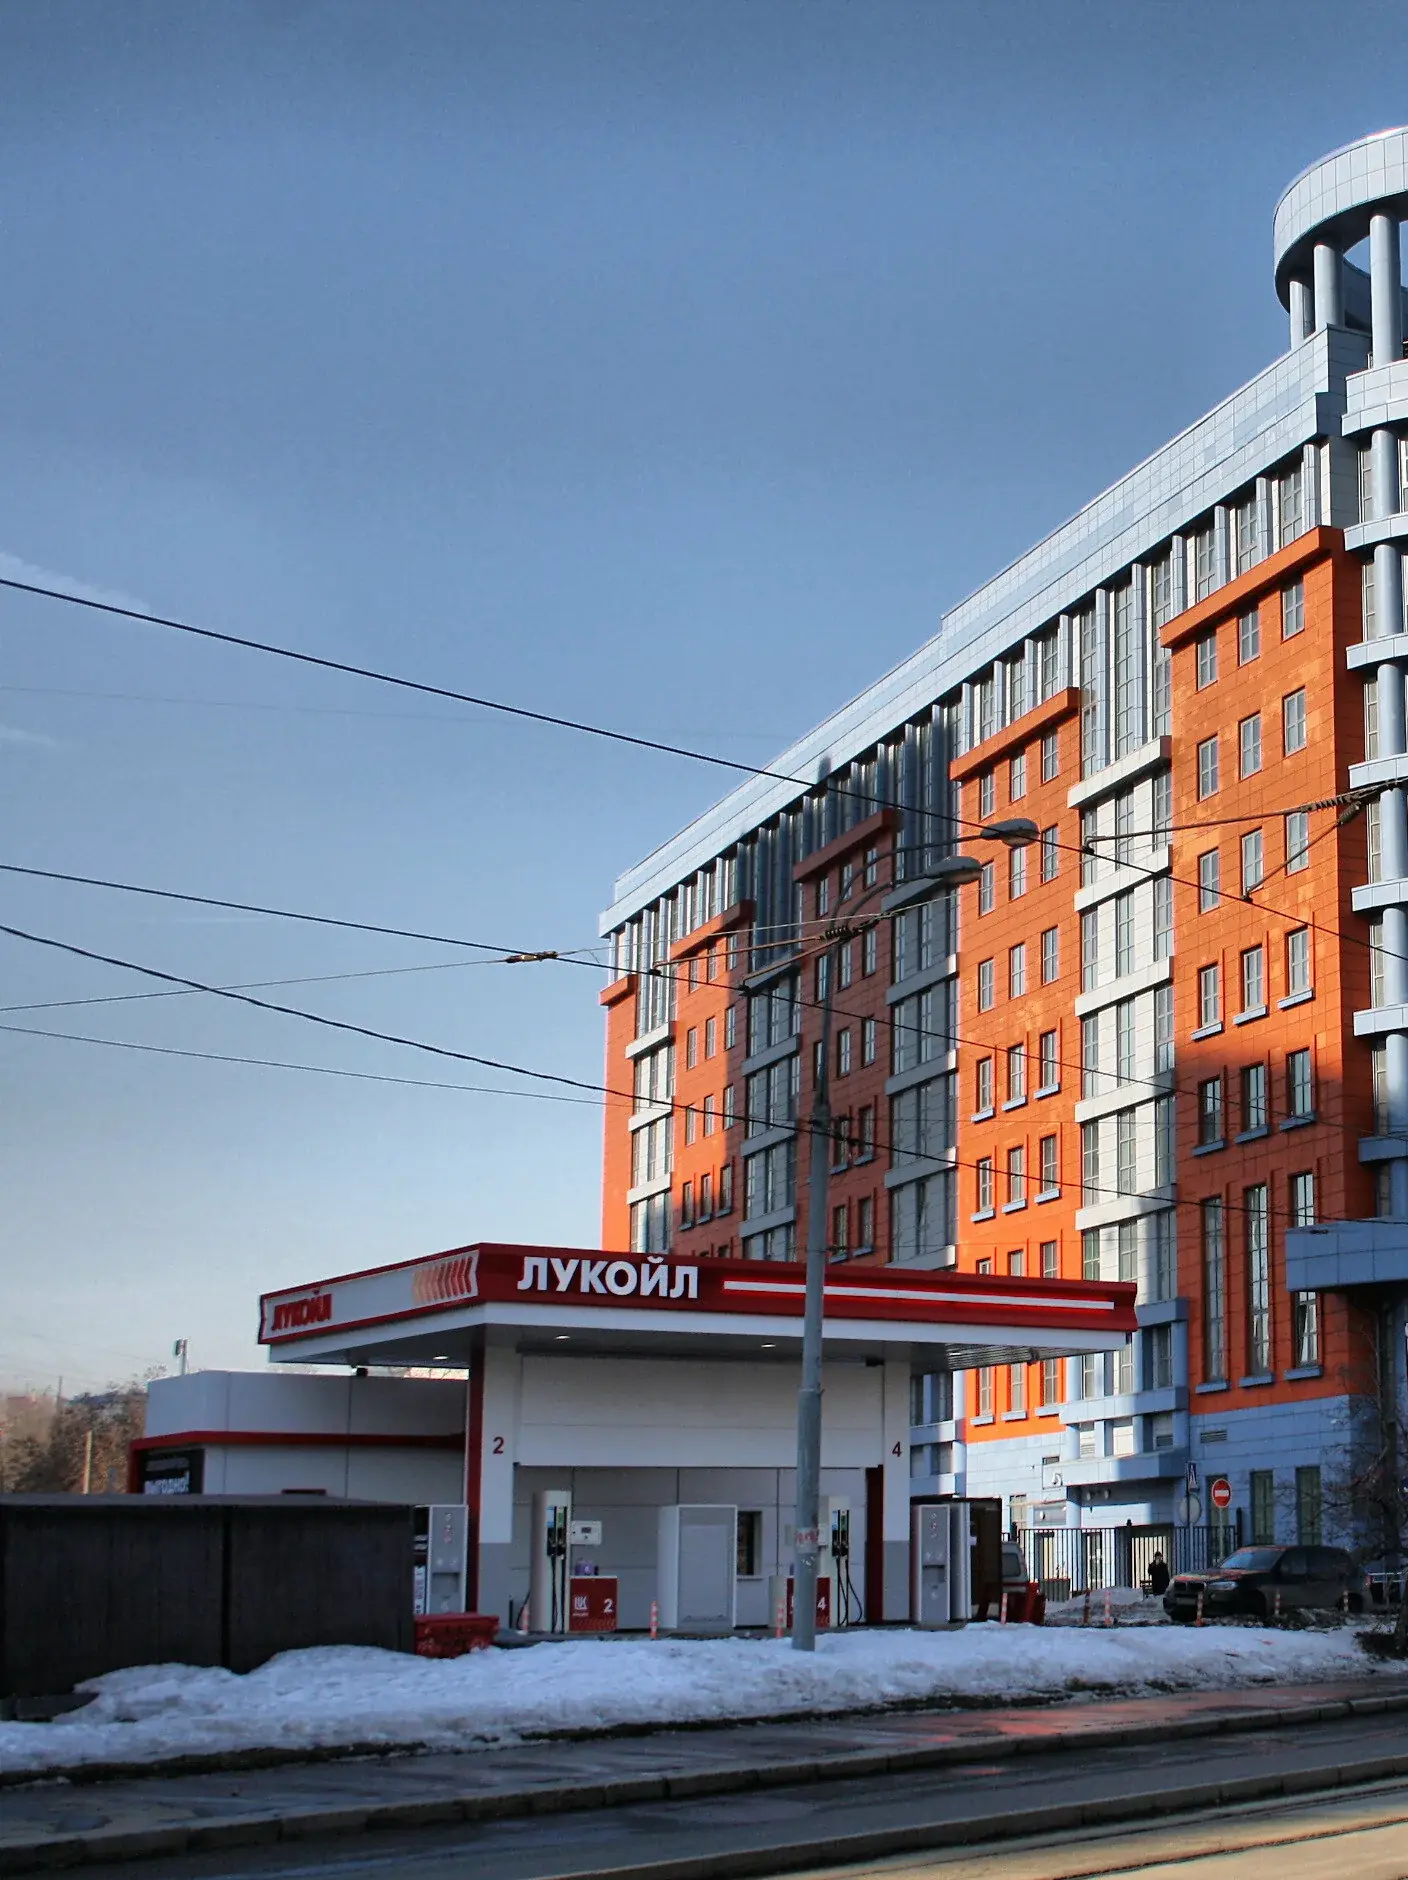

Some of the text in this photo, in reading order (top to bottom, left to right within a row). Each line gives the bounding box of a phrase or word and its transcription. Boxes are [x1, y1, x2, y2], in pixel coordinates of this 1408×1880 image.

[517, 1256, 699, 1299] ЛУКОЙЛ
[492, 1436, 505, 1454] 2
[891, 1441, 902, 1458] 4
[603, 1598, 613, 1613] 2
[817, 1596, 826, 1610] 4
